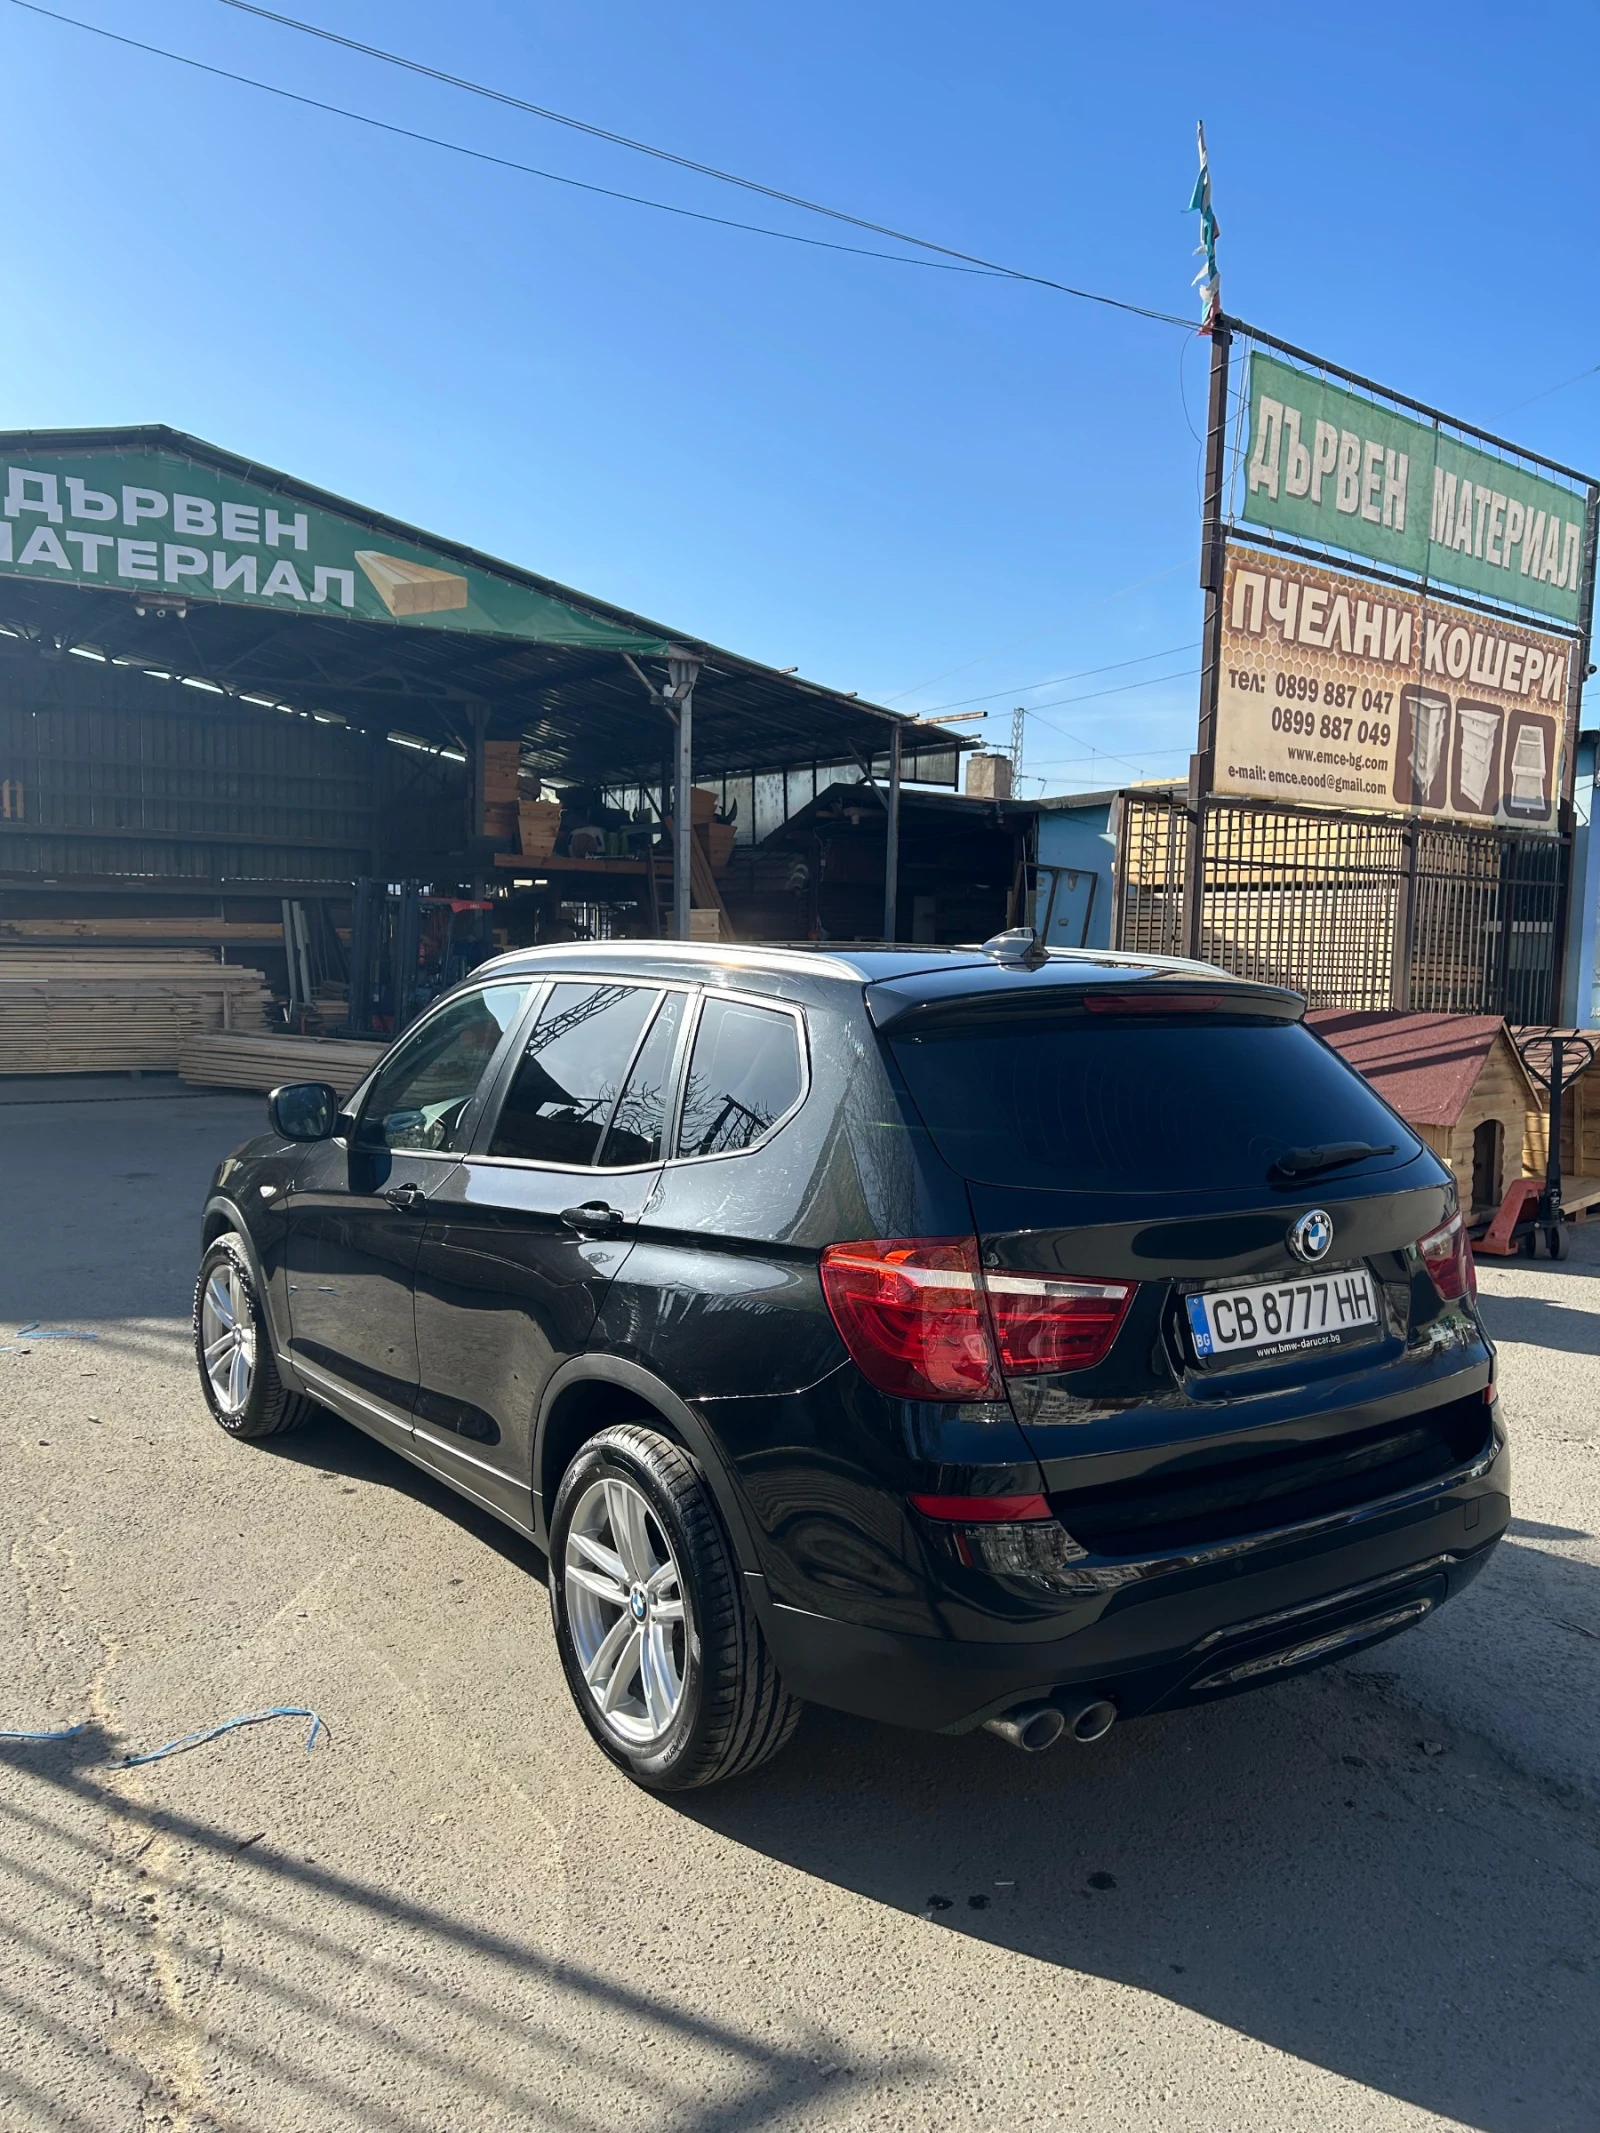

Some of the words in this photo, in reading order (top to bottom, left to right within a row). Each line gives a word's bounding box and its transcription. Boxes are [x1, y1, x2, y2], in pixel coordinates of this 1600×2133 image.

[4, 466, 308, 551] ДЪРВЕН
[1249, 395, 1409, 532] ДЪРВЕН
[1430, 465, 1581, 591] МАТЕРИАЛ
[1231, 569, 1413, 665] ПЧЕЛНИ
[1424, 614, 1566, 702] КОШЕРИ
[1228, 668, 1266, 694] тел:
[1275, 672, 1319, 703] 0899
[1323, 681, 1358, 709] 887
[1361, 688, 1394, 715] 047
[1271, 706, 1316, 736] 0899
[1319, 714, 1353, 741] 887
[1357, 720, 1391, 747] 049
[1228, 765, 1267, 781] e-mail:
[1268, 770, 1387, 795] emce.eood@gmail.com
[1287, 747, 1388, 771] www.emce-bg.com
[1212, 1296, 1258, 1344] CB
[1262, 1283, 1329, 1335] 8777
[1334, 1276, 1372, 1322] HH
[1196, 1333, 1211, 1348] BG
[1256, 1333, 1341, 1357] www.bmw-darucar.bg
